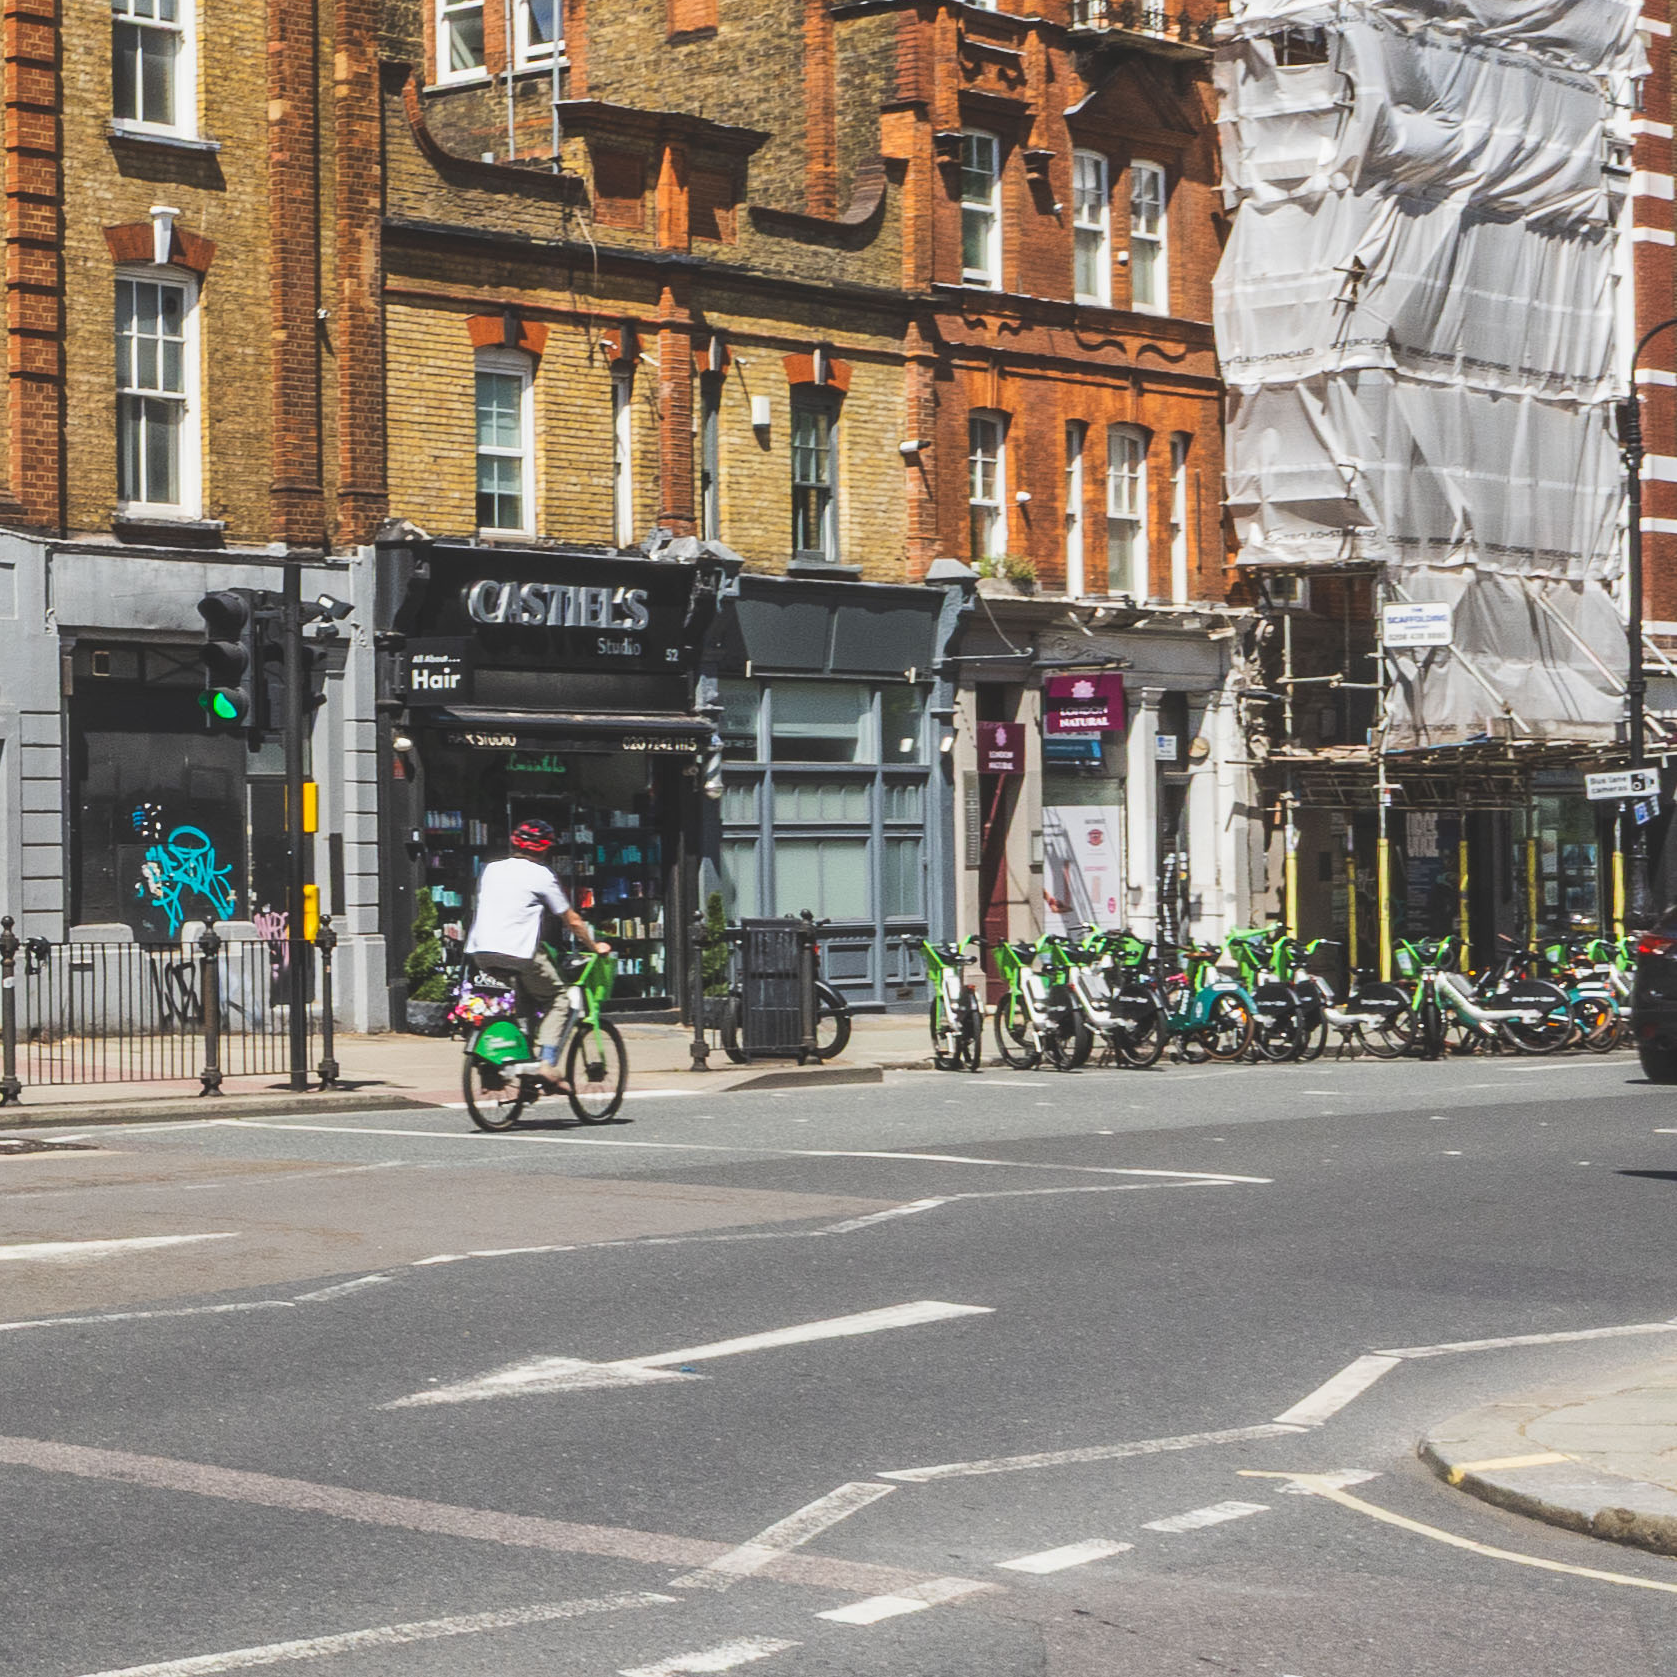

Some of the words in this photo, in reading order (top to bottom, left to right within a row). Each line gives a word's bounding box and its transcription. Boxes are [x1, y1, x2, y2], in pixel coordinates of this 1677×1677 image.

[467, 580, 648, 630] CASTIEL'S
[598, 638, 642, 655] Studio
[665, 648, 679, 661] 52
[412, 667, 461, 689] Hair
[1059, 717, 1110, 728] NATURAL
[476, 732, 517, 747] STUDIO
